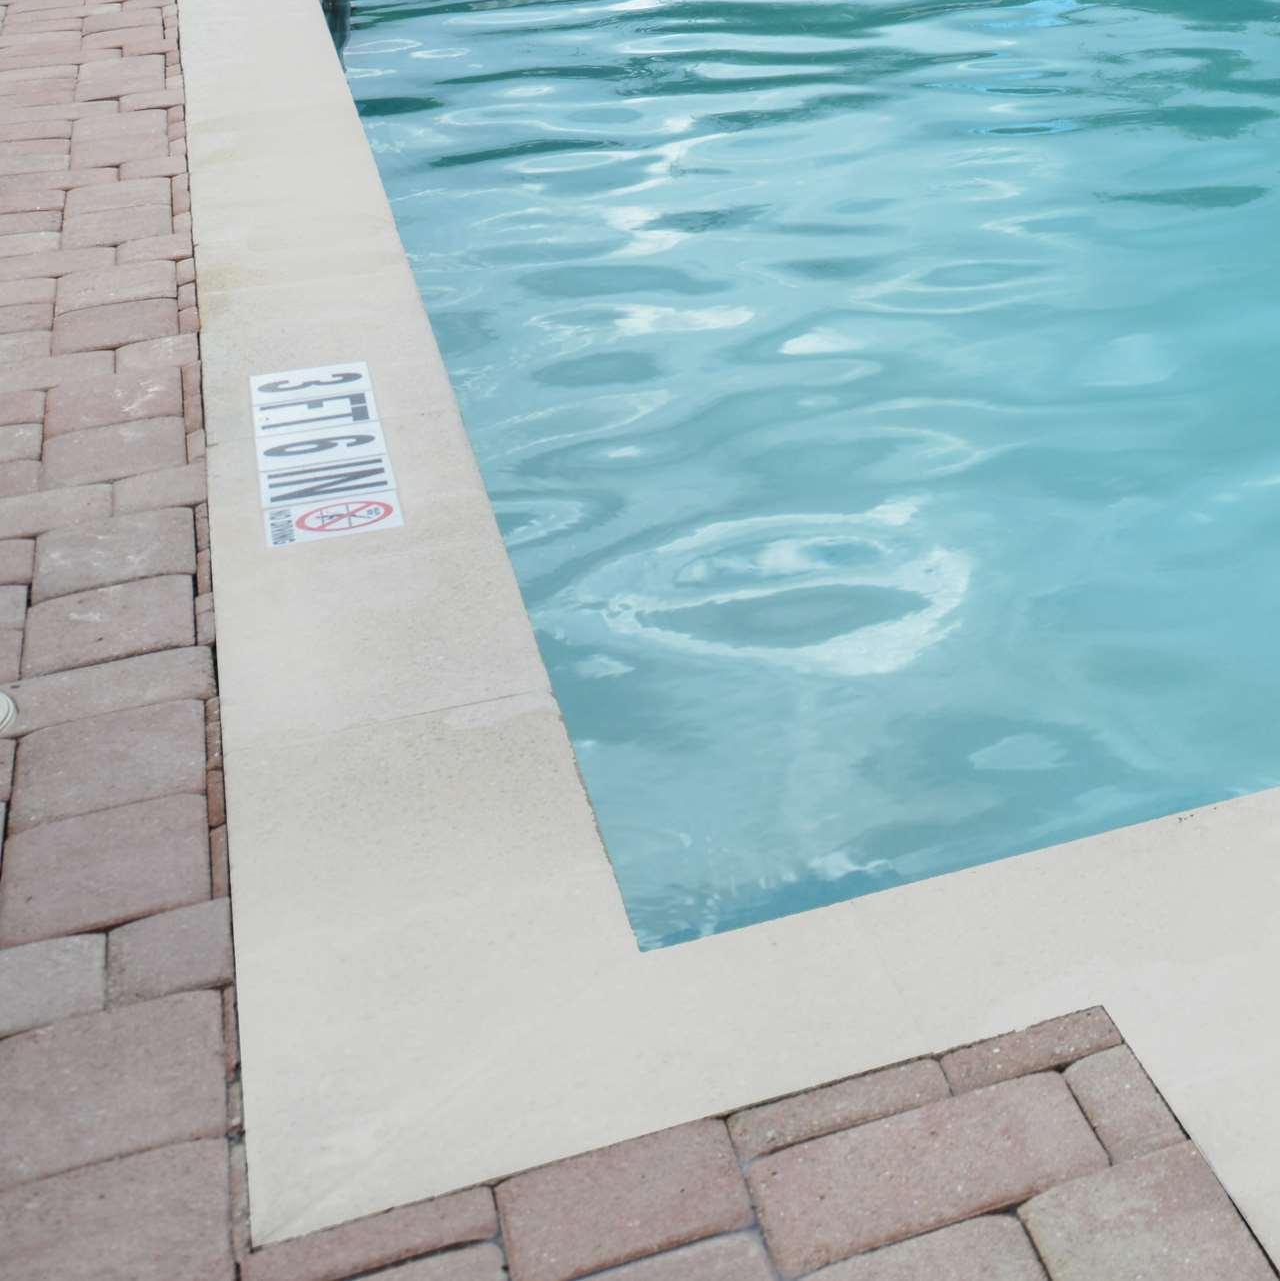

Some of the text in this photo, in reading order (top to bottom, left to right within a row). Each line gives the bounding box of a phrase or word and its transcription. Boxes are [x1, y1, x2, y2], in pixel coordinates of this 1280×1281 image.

[257, 372, 389, 504] 3 FT 6 IN
